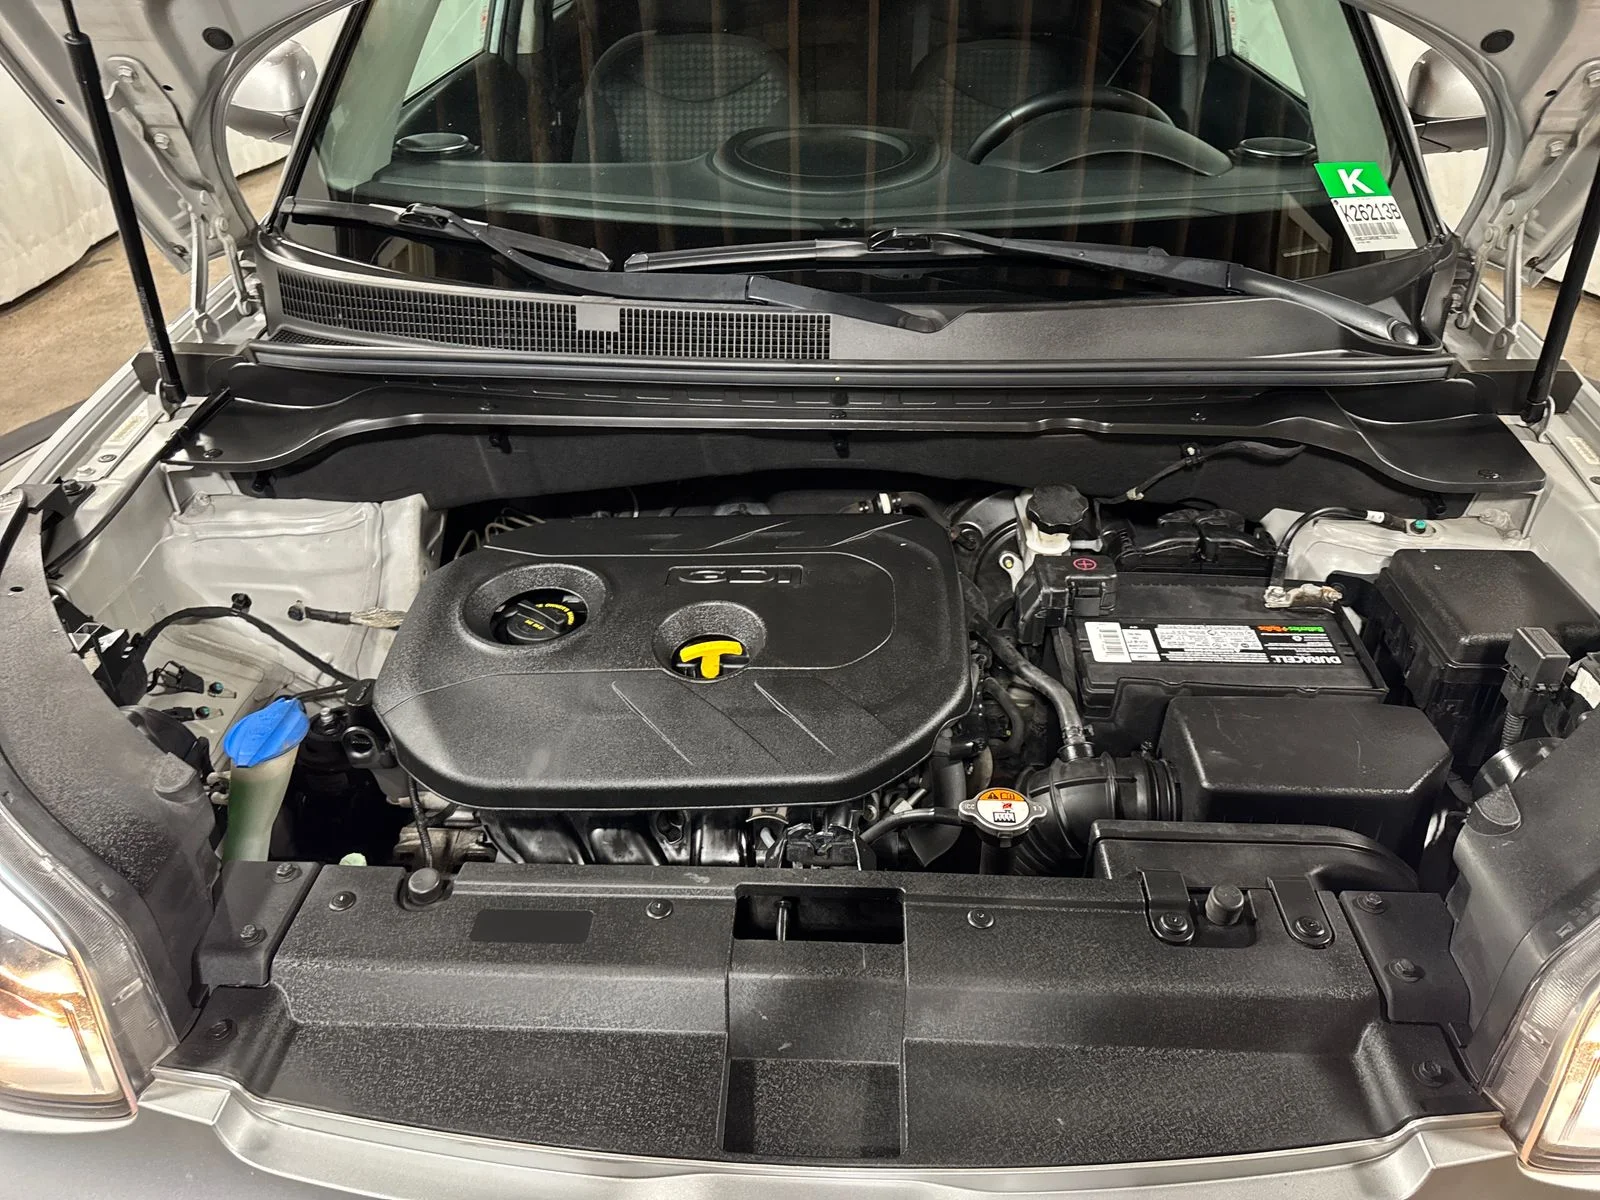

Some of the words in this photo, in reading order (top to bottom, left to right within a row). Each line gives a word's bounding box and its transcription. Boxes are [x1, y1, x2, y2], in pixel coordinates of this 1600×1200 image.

[1337, 168, 1375, 194] K
[1339, 202, 1401, 222] K26213B
[678, 569, 791, 584] GDI
[1270, 655, 1343, 664] DURACELL
